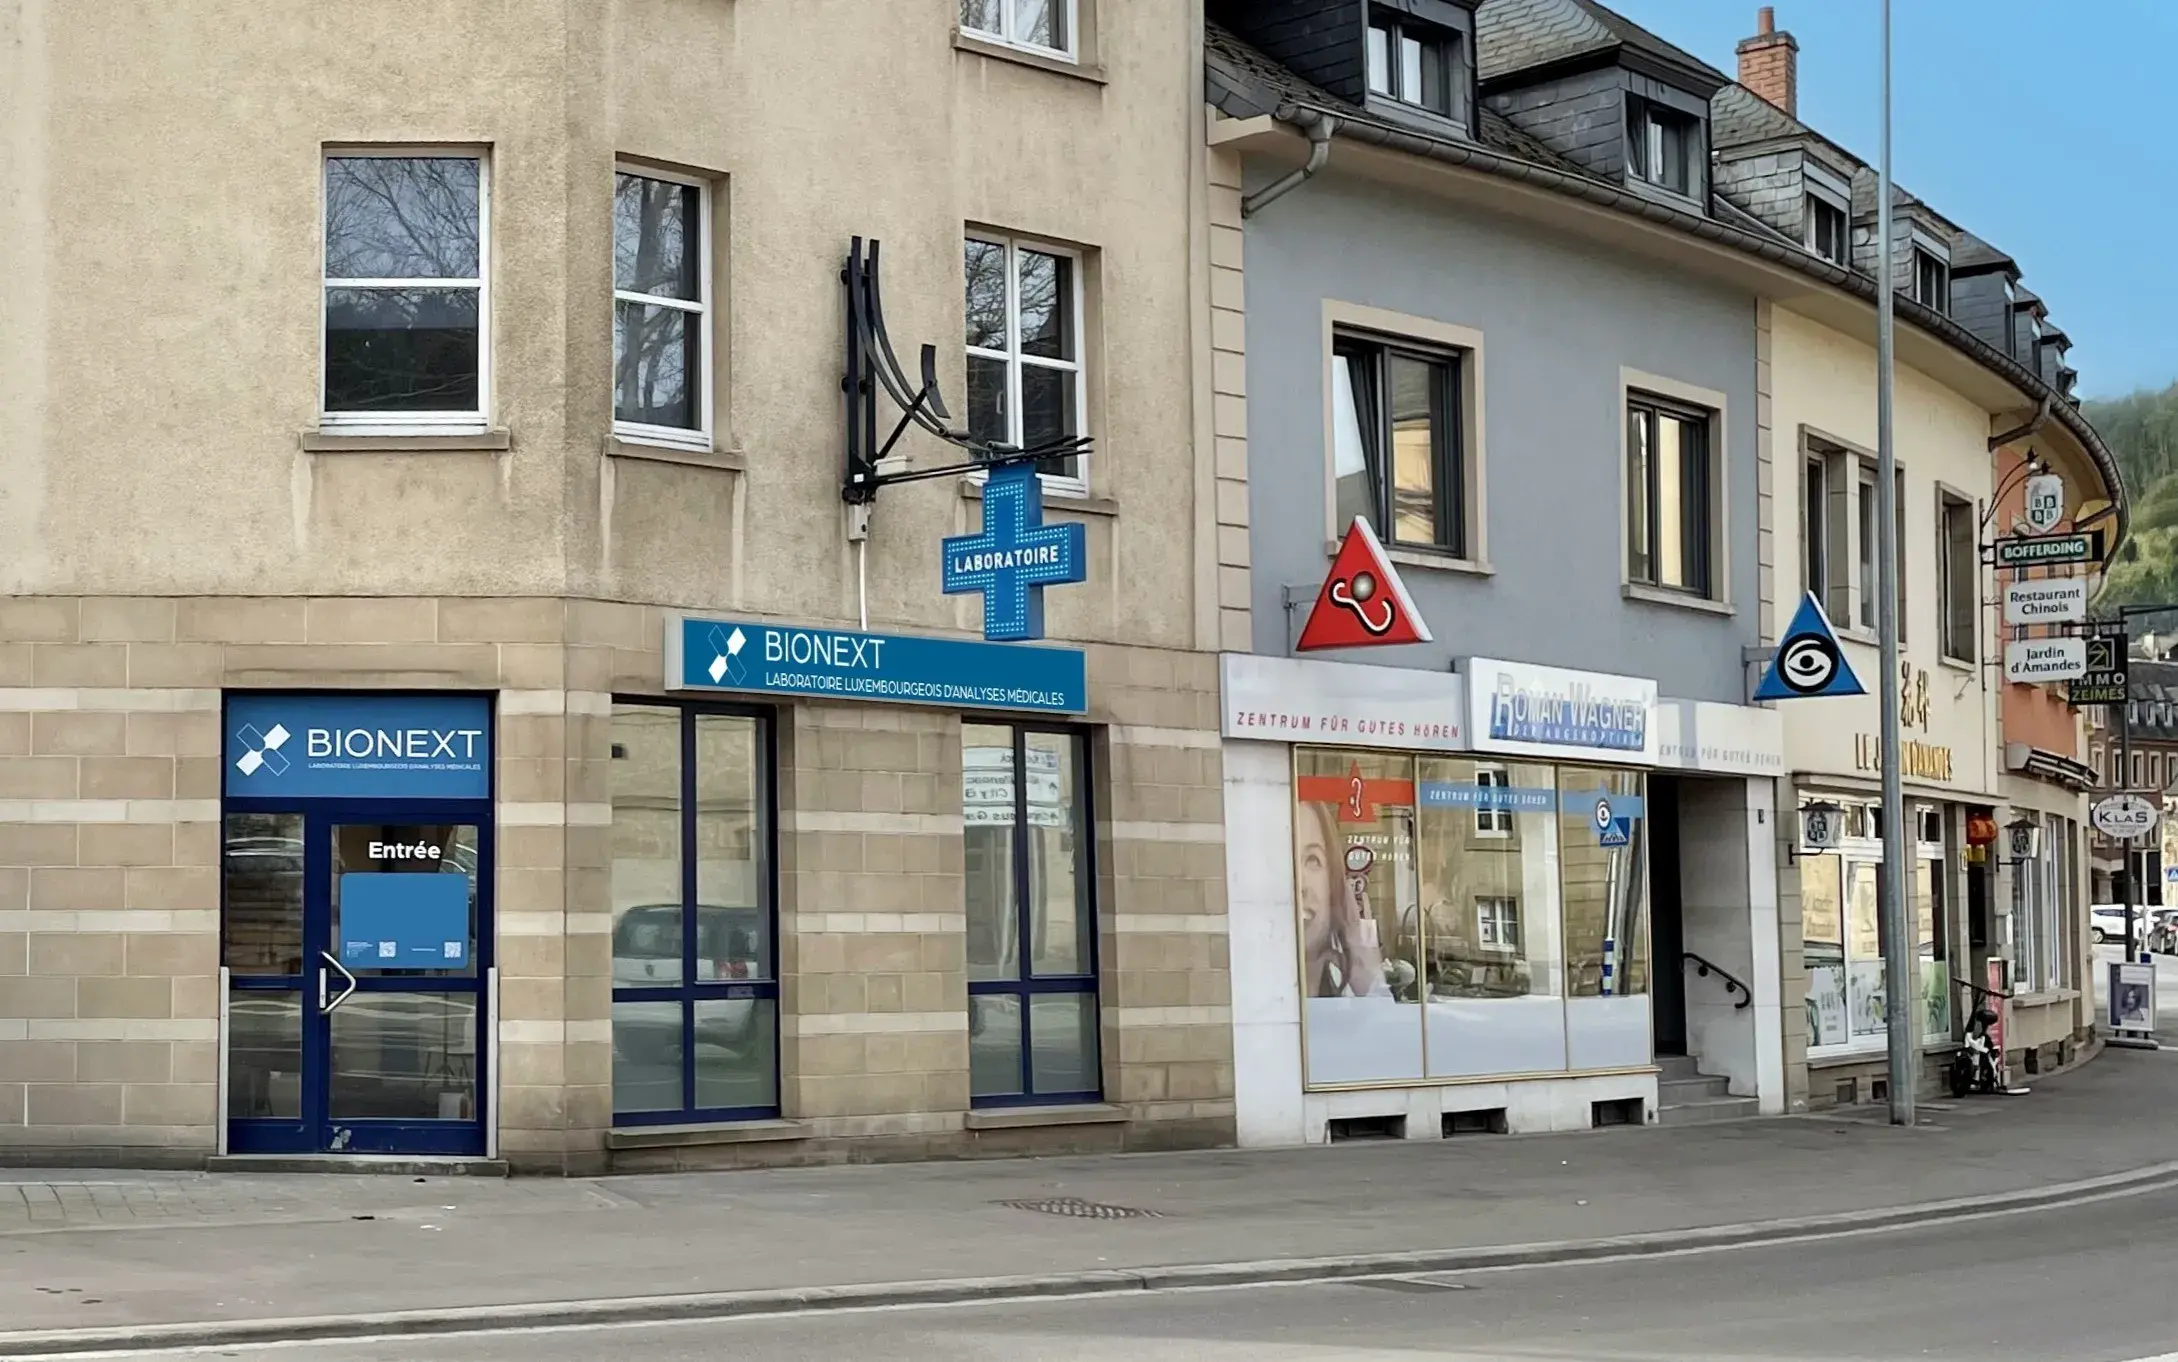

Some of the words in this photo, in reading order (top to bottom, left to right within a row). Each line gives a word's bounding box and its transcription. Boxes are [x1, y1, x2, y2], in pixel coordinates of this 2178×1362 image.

[2004, 541, 2085, 559] BOFFERDING
[955, 545, 1059, 574] LABORATOIRE
[2010, 588, 2081, 602] Restaurant
[2021, 602, 2069, 615] Chinois
[765, 630, 886, 669] BIONEXT
[2026, 646, 2065, 661] Jardin
[2011, 658, 2082, 673] d'Amandes
[765, 671, 843, 691] LABORATOIRE
[845, 677, 942, 698] LUXEMBOURGEOIS
[944, 685, 1006, 702] D'ANALYSES
[1007, 687, 1065, 706] MÉDICALES
[2072, 687, 2126, 701] ZEIMES
[1237, 711, 1311, 729] ZENTRUM
[1320, 715, 1349, 732] FÜR
[1357, 721, 1405, 736] GUTES
[307, 729, 483, 758] BIONEXT
[368, 840, 441, 859] Entrée
